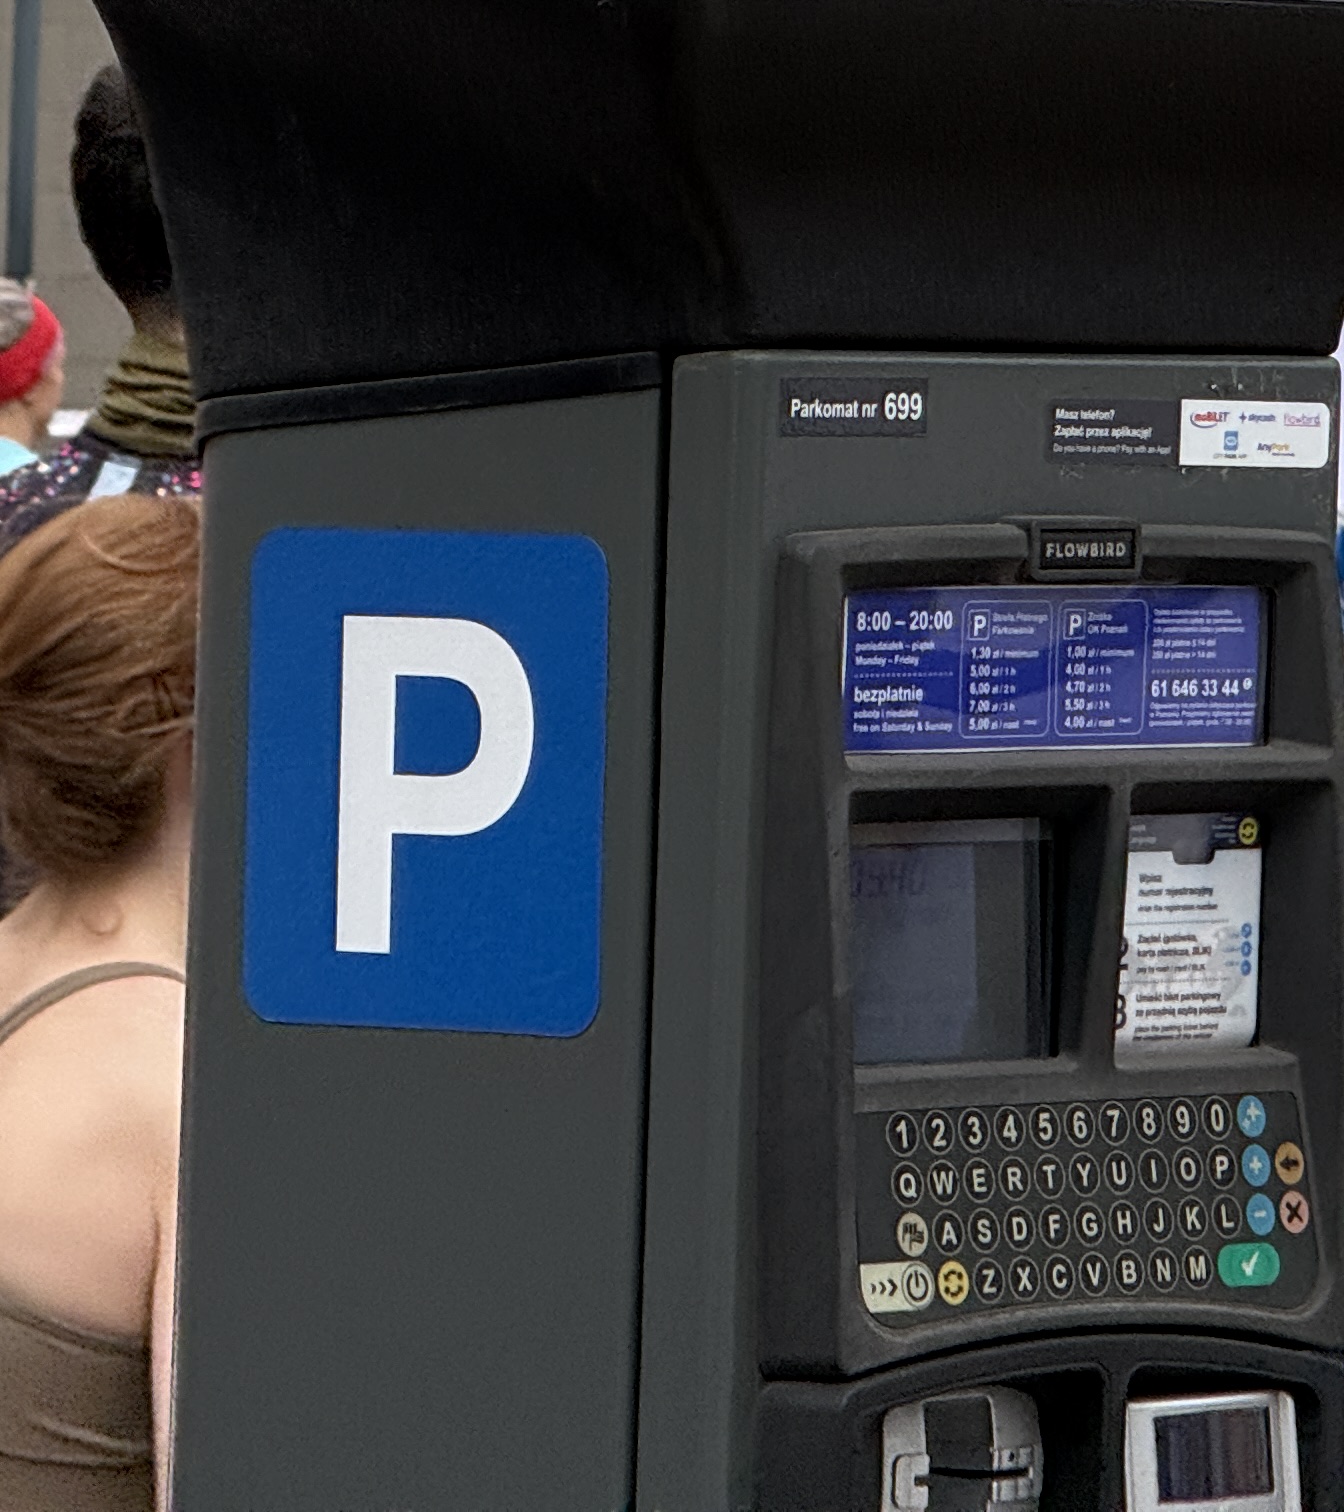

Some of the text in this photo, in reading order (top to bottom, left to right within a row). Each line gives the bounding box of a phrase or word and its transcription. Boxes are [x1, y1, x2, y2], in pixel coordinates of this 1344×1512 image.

[790, 391, 924, 421] Parkomat nr 699
[1045, 541, 1127, 559] FLOWBIRD
[856, 611, 892, 632] 8:00
[909, 610, 954, 631] 20:00
[972, 614, 988, 637] P
[1068, 613, 1083, 637] P
[853, 684, 924, 707] bezpłatnie
[1151, 678, 1240, 698] 61 646 33 44
[335, 614, 535, 954] P
[896, 1119, 909, 1149] 1
[931, 1118, 947, 1148] 2
[967, 1115, 983, 1145] 3
[1002, 1114, 1018, 1143] 4
[1038, 1112, 1054, 1141] 5
[1072, 1111, 1088, 1139] 6
[1106, 1109, 1121, 1137] 7
[1141, 1107, 1157, 1135] 8
[1175, 1105, 1190, 1134] 9
[899, 1172, 918, 1198] Q
[932, 1170, 954, 1195] W
[972, 1168, 988, 1193] E
[1006, 1167, 1024, 1192] R
[1041, 1164, 1057, 1189] T
[1076, 1162, 1092, 1187] Y
[1111, 1160, 1128, 1186] U
[1215, 1155, 1229, 1180] P
[941, 1203, 1235, 1246] A S D F G H J K L
[982, 1255, 1207, 1294] Z X C V B N M
